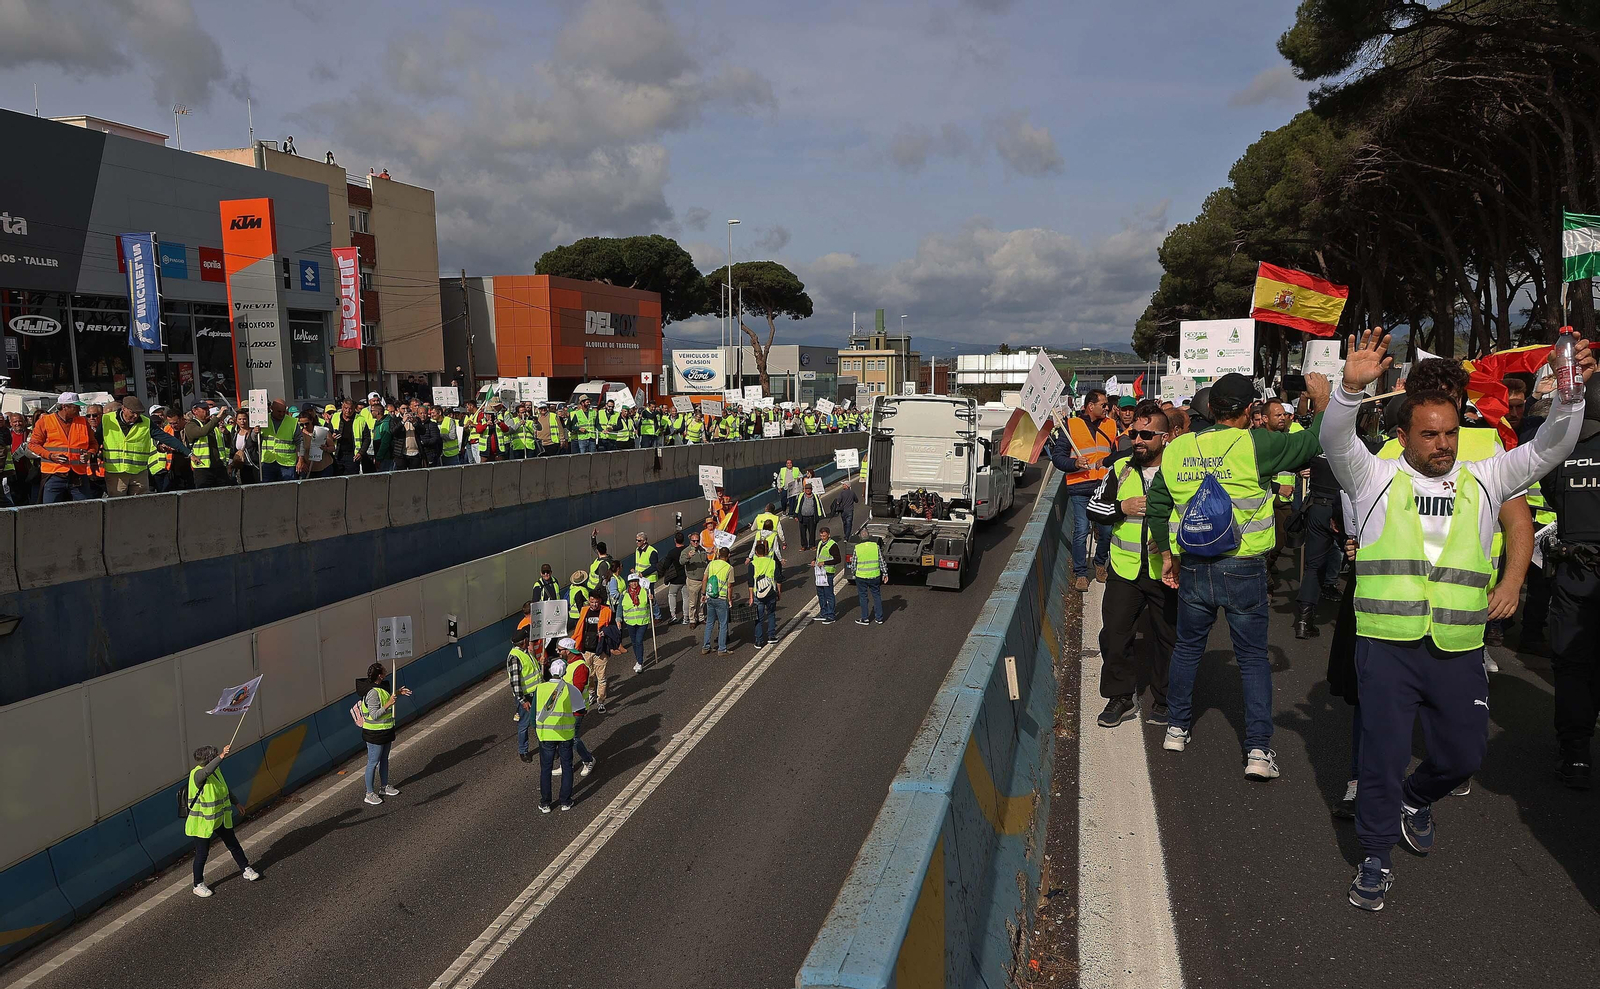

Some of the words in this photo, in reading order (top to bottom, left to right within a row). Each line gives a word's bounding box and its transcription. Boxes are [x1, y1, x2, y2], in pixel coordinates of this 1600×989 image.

[230, 215, 262, 230] KTM
[23, 256, 59, 267] TALLER
[203, 260, 222, 269] aprilia
[132, 243, 147, 318] MICHELIN
[338, 255, 358, 340] MOTUL
[17, 320, 55, 332] HJC
[86, 324, 127, 332] REV'IT!
[249, 321, 275, 329] OXFORD
[585, 310, 638, 337] DELBOX
[294, 329, 319, 341] LeoVince
[585, 341, 608, 349] ALQUILER
[246, 359, 272, 369] Unibat
[687, 368, 710, 380] Ford
[1216, 366, 1236, 374] Campo
[1564, 457, 1600, 468] POL
